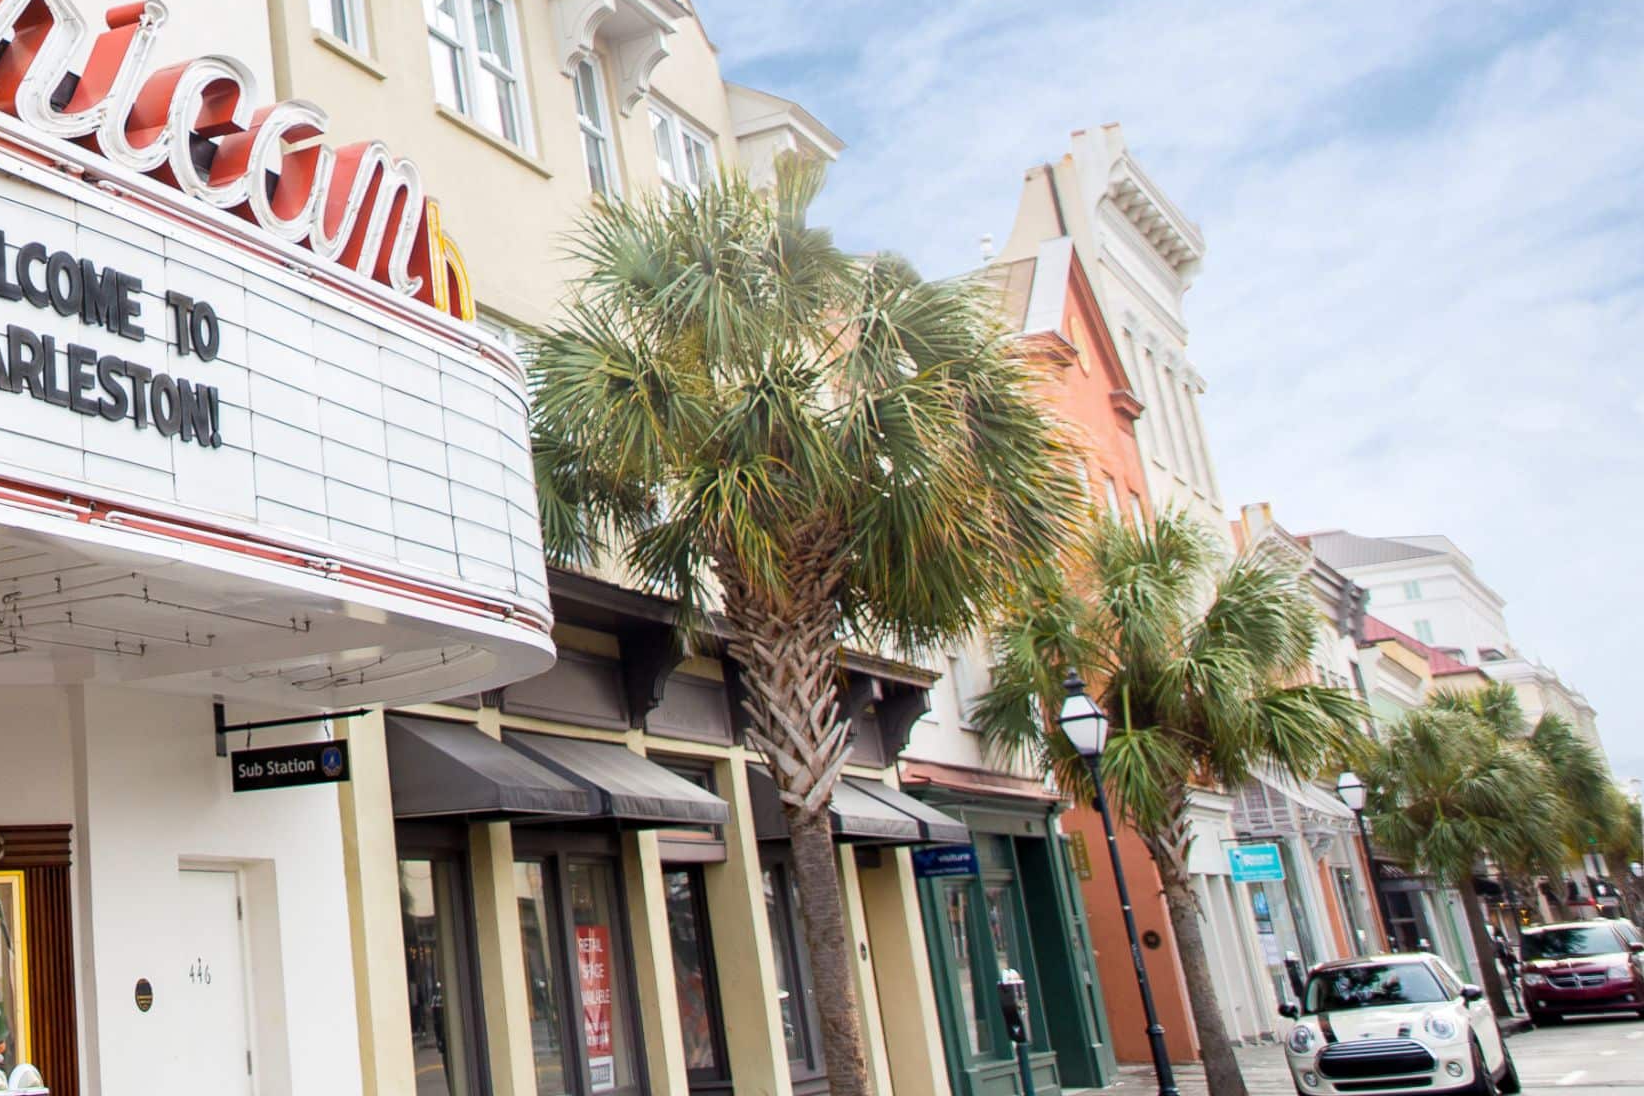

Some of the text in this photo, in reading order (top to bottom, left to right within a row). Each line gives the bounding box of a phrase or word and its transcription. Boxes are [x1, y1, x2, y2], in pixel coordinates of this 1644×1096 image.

[165, 289, 220, 362] TO
[238, 757, 316, 779] Sub Station
[189, 963, 211, 985] 446
